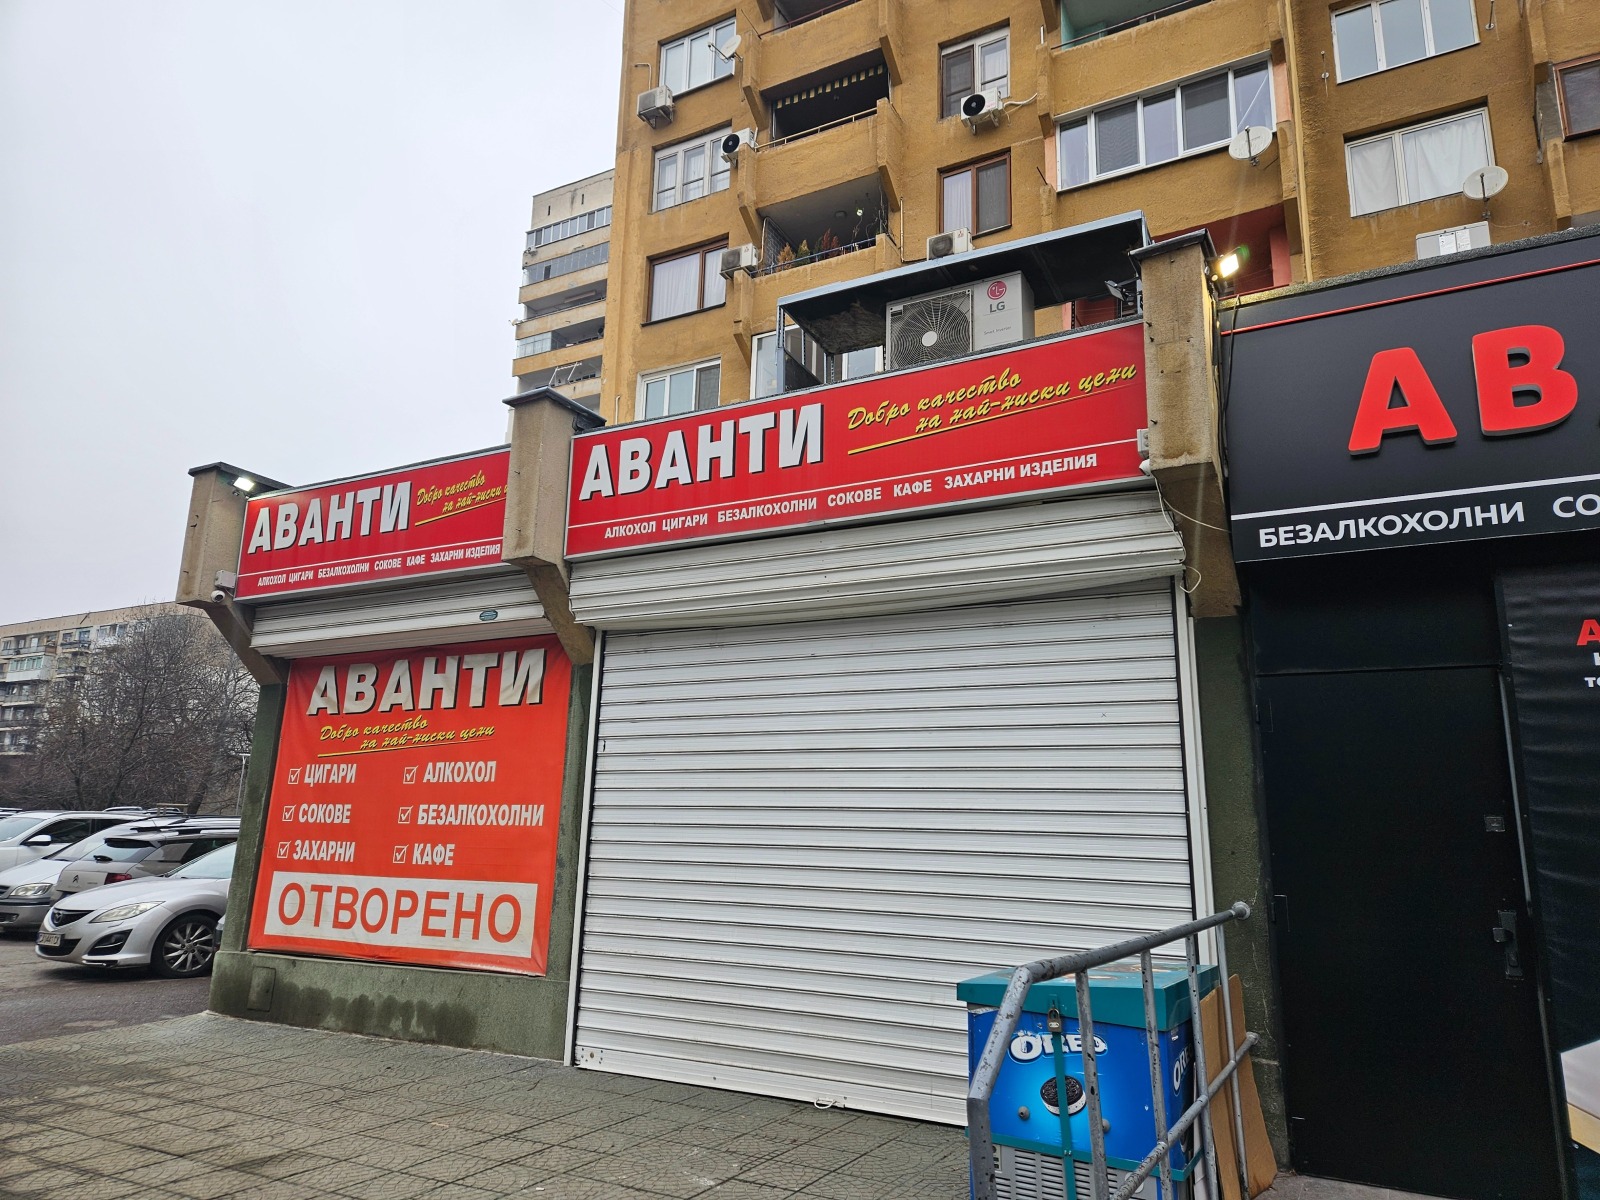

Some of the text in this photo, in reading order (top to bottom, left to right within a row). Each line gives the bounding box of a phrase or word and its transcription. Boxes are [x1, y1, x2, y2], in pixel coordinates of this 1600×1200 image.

[989, 301, 1005, 313] LG
[847, 367, 1023, 431] Добро качество
[915, 363, 1138, 433] на най-ниски цени
[578, 402, 824, 502] АВАНТИ
[416, 485, 442, 505] Добро
[444, 470, 485, 496] качество
[604, 453, 1098, 539] АЛКОХОЛ ЦИГАРИ БЕЗАЛКОХОЛНИ СОКОВЕ КАФЕ ЗАХАРНИ ИЗДЕЛИЯ
[248, 480, 413, 554] АВАНТИ
[1258, 501, 1525, 549] БЕЗАЛКОХОЛНИ
[258, 544, 501, 587] АЛКОХОЛ ЦИГАРИ БЕЗАЛКОХОЛНИ СОКОВЕ КАФЕ ЗАХАРНИ ИЗДЕЛИЯ
[306, 648, 546, 716] АВАНТИ
[319, 714, 428, 742] Добро качество
[360, 724, 496, 750] на най-ниски цени
[304, 764, 357, 788] ЦИГАРИ
[422, 760, 497, 784] АЛКОХОЛ
[298, 804, 352, 825] СОКОВЕ
[416, 804, 545, 828] БЕЗАЛКОХОЛНИ
[292, 840, 356, 863] ЗАХАРНИ
[411, 844, 456, 866] КАФЕ
[278, 882, 522, 944] ОТВОРЕНО
